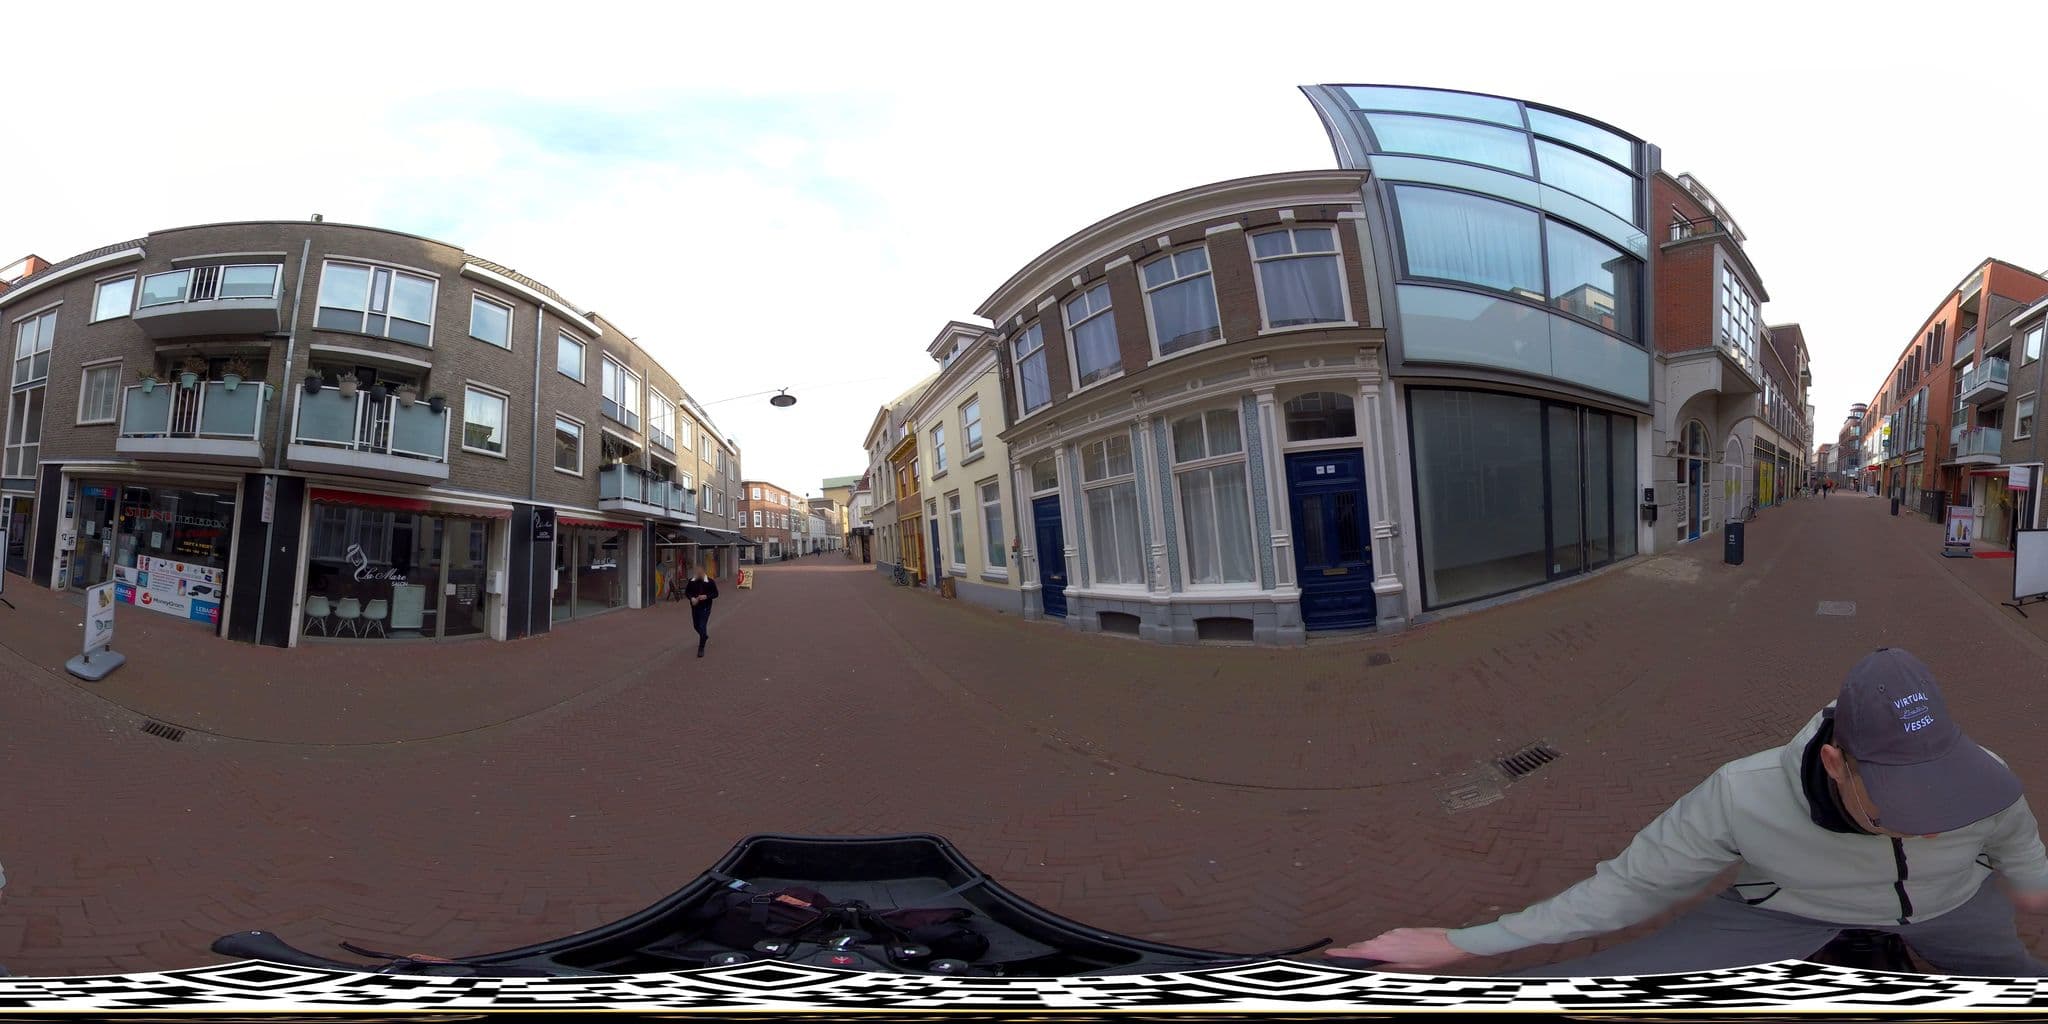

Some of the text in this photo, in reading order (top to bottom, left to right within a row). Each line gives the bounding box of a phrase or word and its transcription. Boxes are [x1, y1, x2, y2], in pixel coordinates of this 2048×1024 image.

[153, 597, 185, 609] MoneyGram
[1894, 693, 1928, 708] VIRTUAL
[1904, 715, 1934, 732] VESSEL
